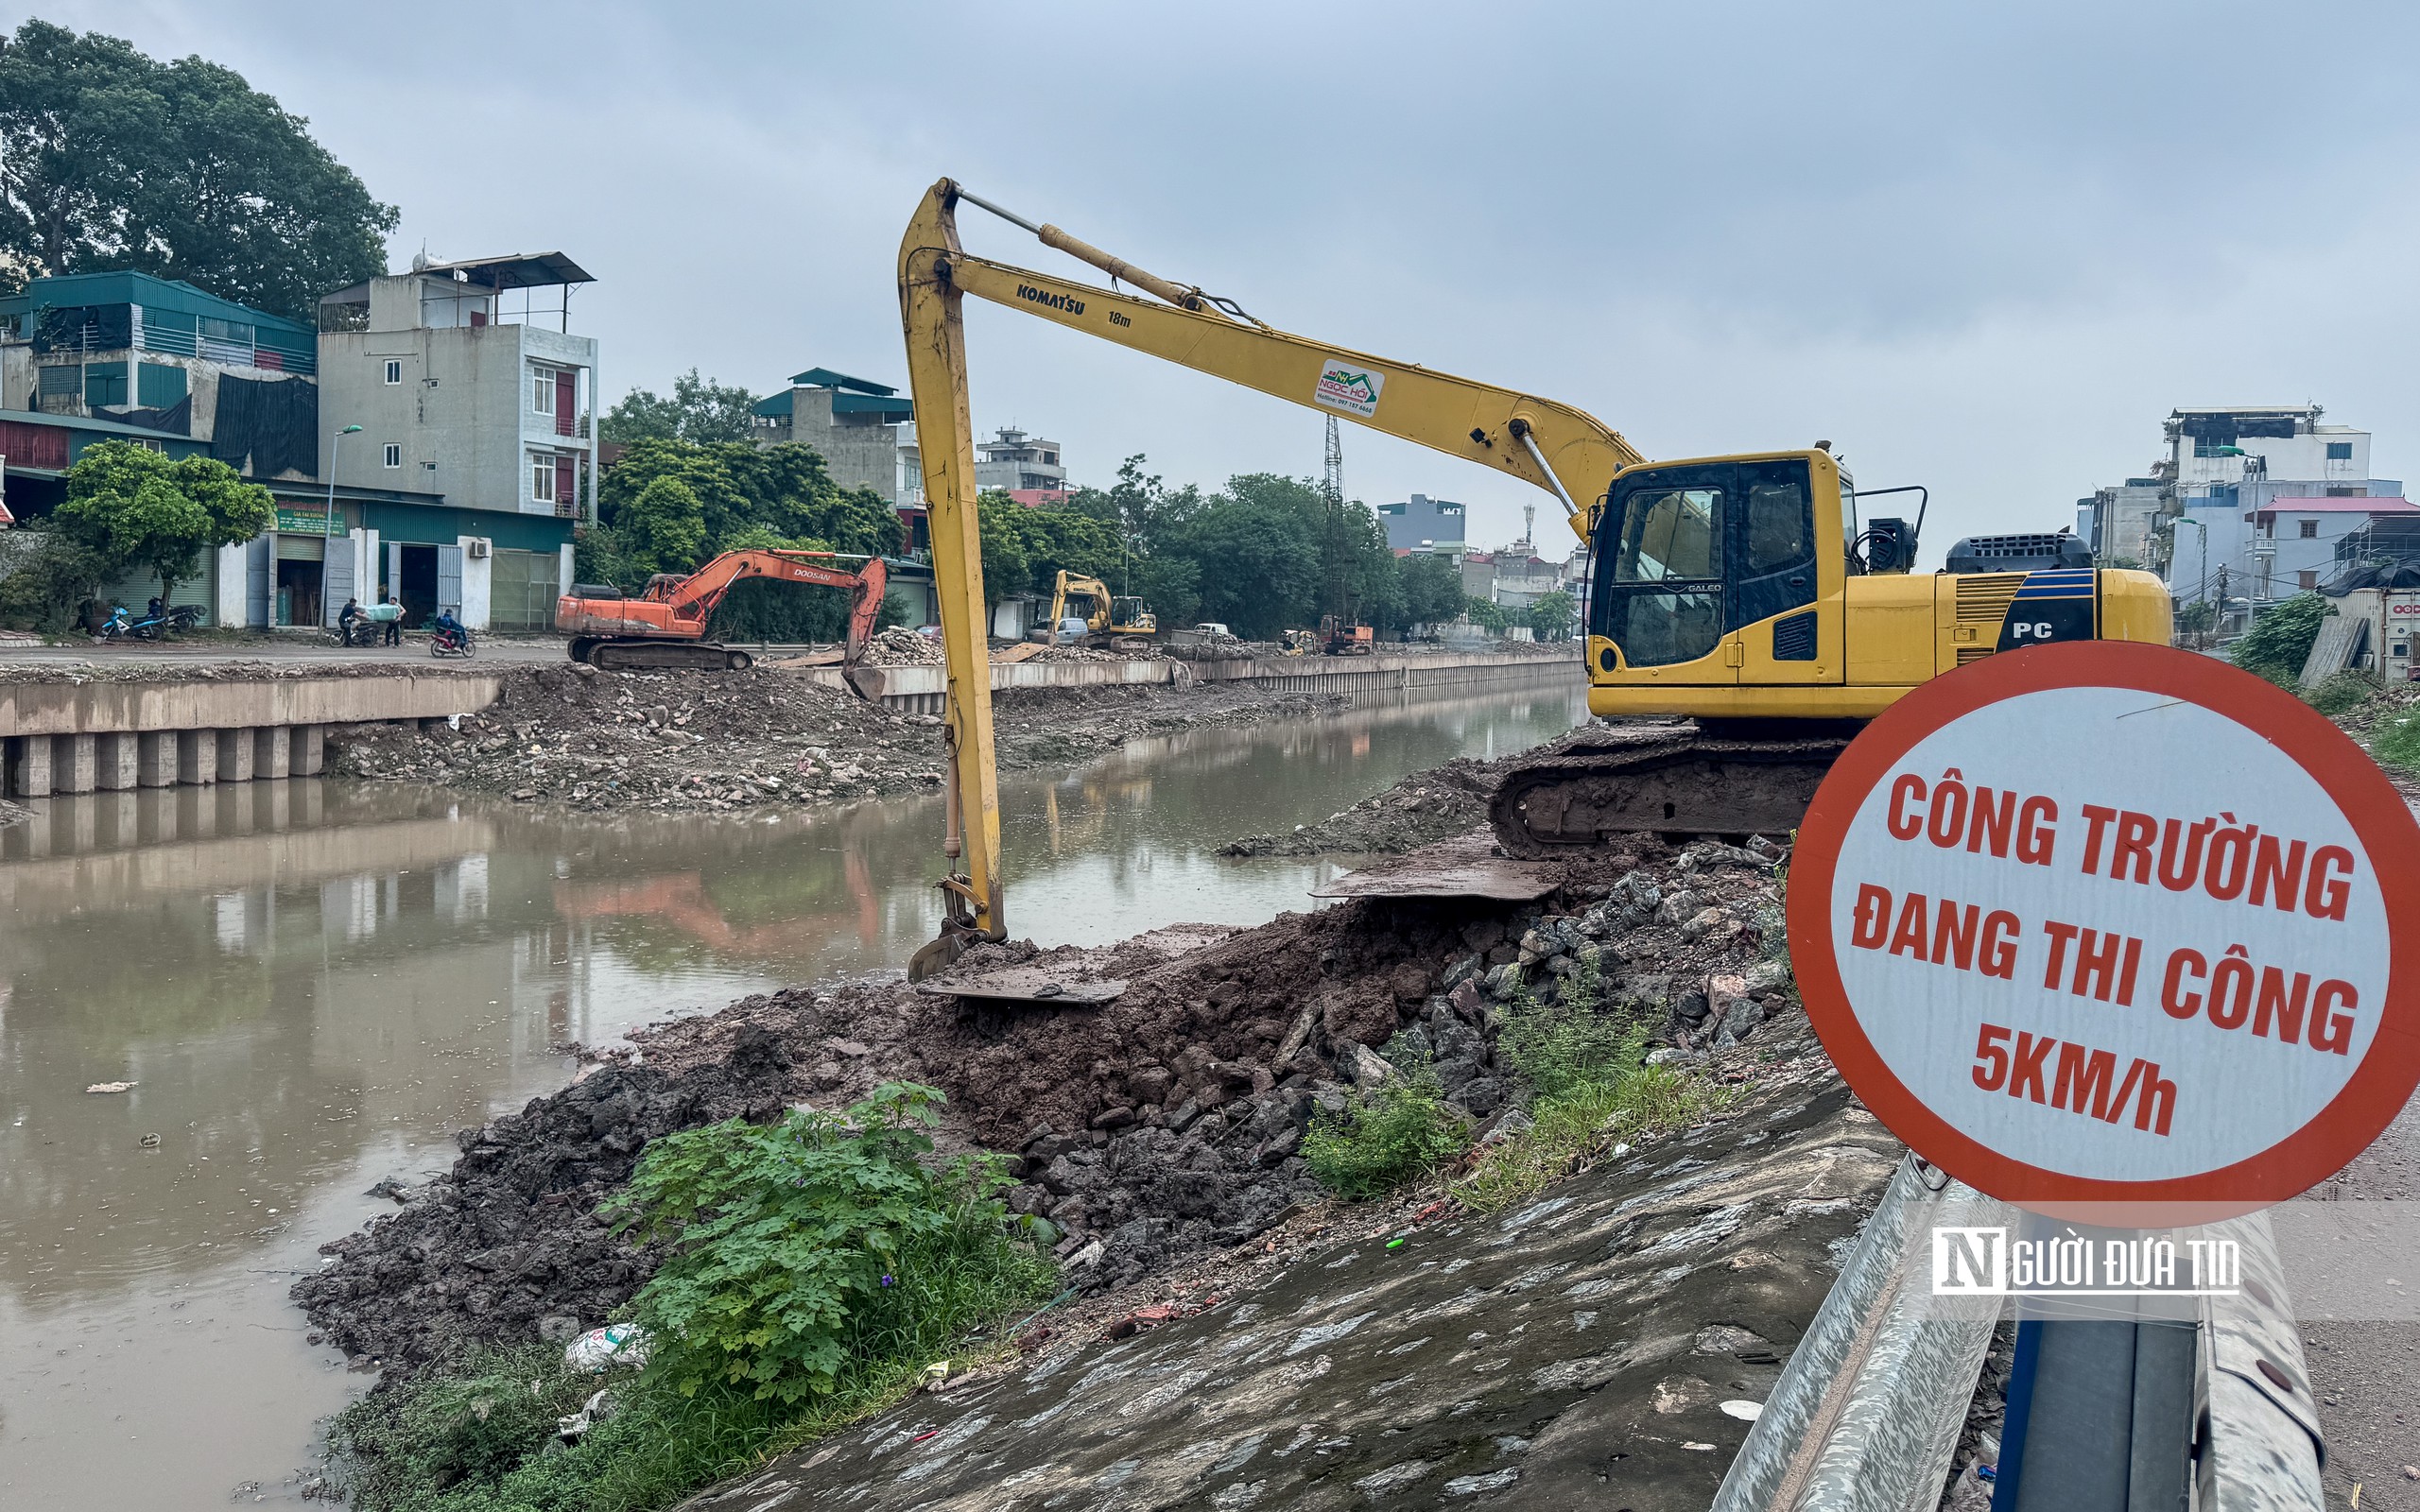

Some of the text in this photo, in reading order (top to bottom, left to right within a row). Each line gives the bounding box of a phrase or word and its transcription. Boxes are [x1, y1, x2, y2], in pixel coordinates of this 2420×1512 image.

[1016, 284, 1132, 328] KOMATSU 18m
[794, 569, 831, 581] DOOSAN
[1688, 584, 1721, 593] GALEO
[2014, 622, 2052, 639] PC
[1889, 768, 2354, 921] CÔNG TRƯỜNG
[1852, 883, 2359, 1056] ĐANG THI CÔNG
[1972, 1023, 2177, 1136] 5KM/h
